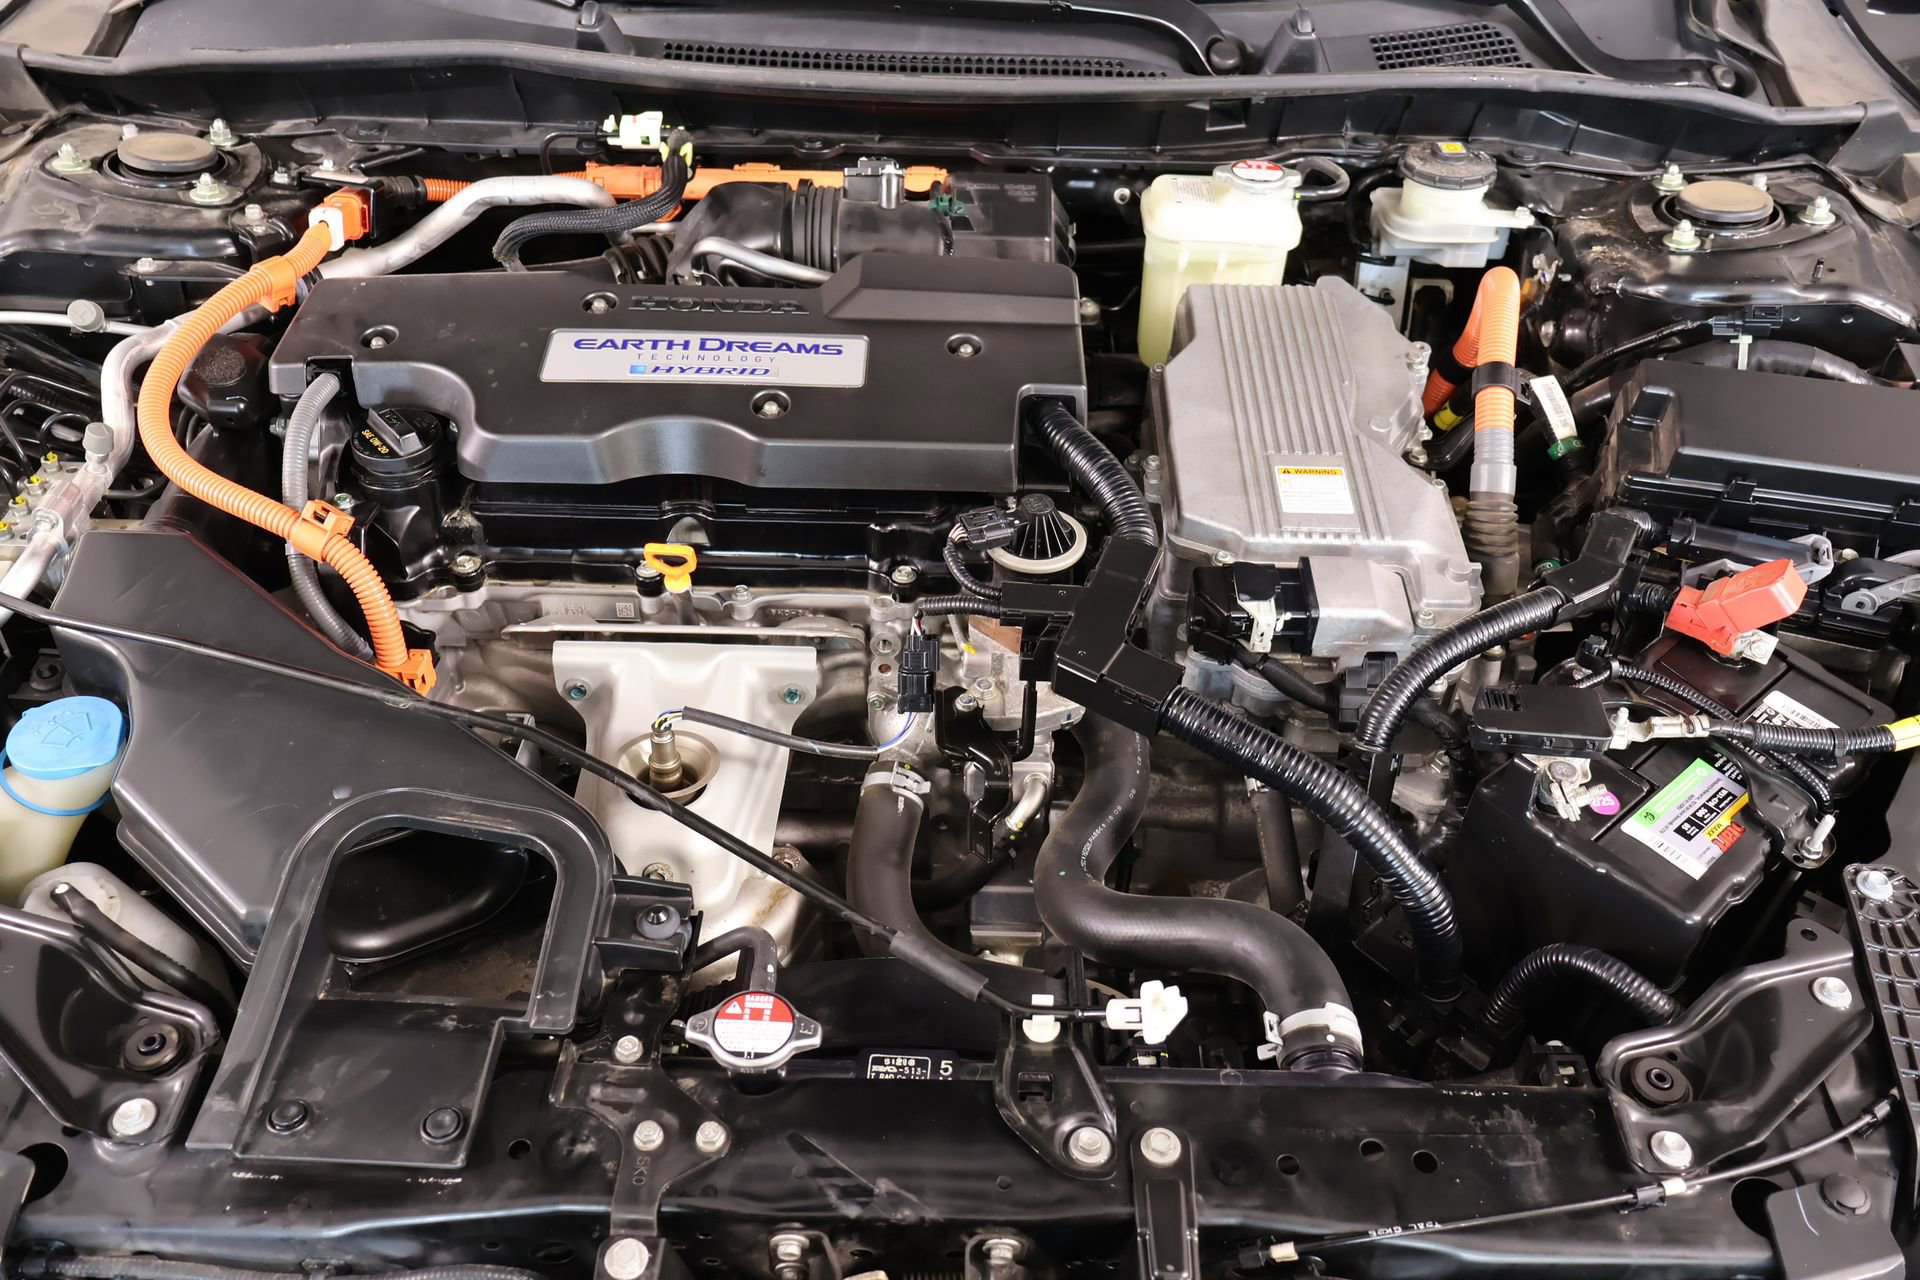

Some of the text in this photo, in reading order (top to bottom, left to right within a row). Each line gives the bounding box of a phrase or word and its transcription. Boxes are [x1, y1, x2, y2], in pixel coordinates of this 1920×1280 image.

[628, 296, 810, 315] HONDA
[573, 337, 844, 356] EARTH DREAMS
[635, 353, 776, 363] TECHNOLOGY
[650, 365, 771, 376] HYBRID
[361, 429, 390, 454] SAE 0W-20
[1293, 468, 1338, 476] WARNING
[1706, 823, 1724, 838] MAXX
[745, 994, 775, 1002] DANGER
[939, 1060, 954, 1076] 5
